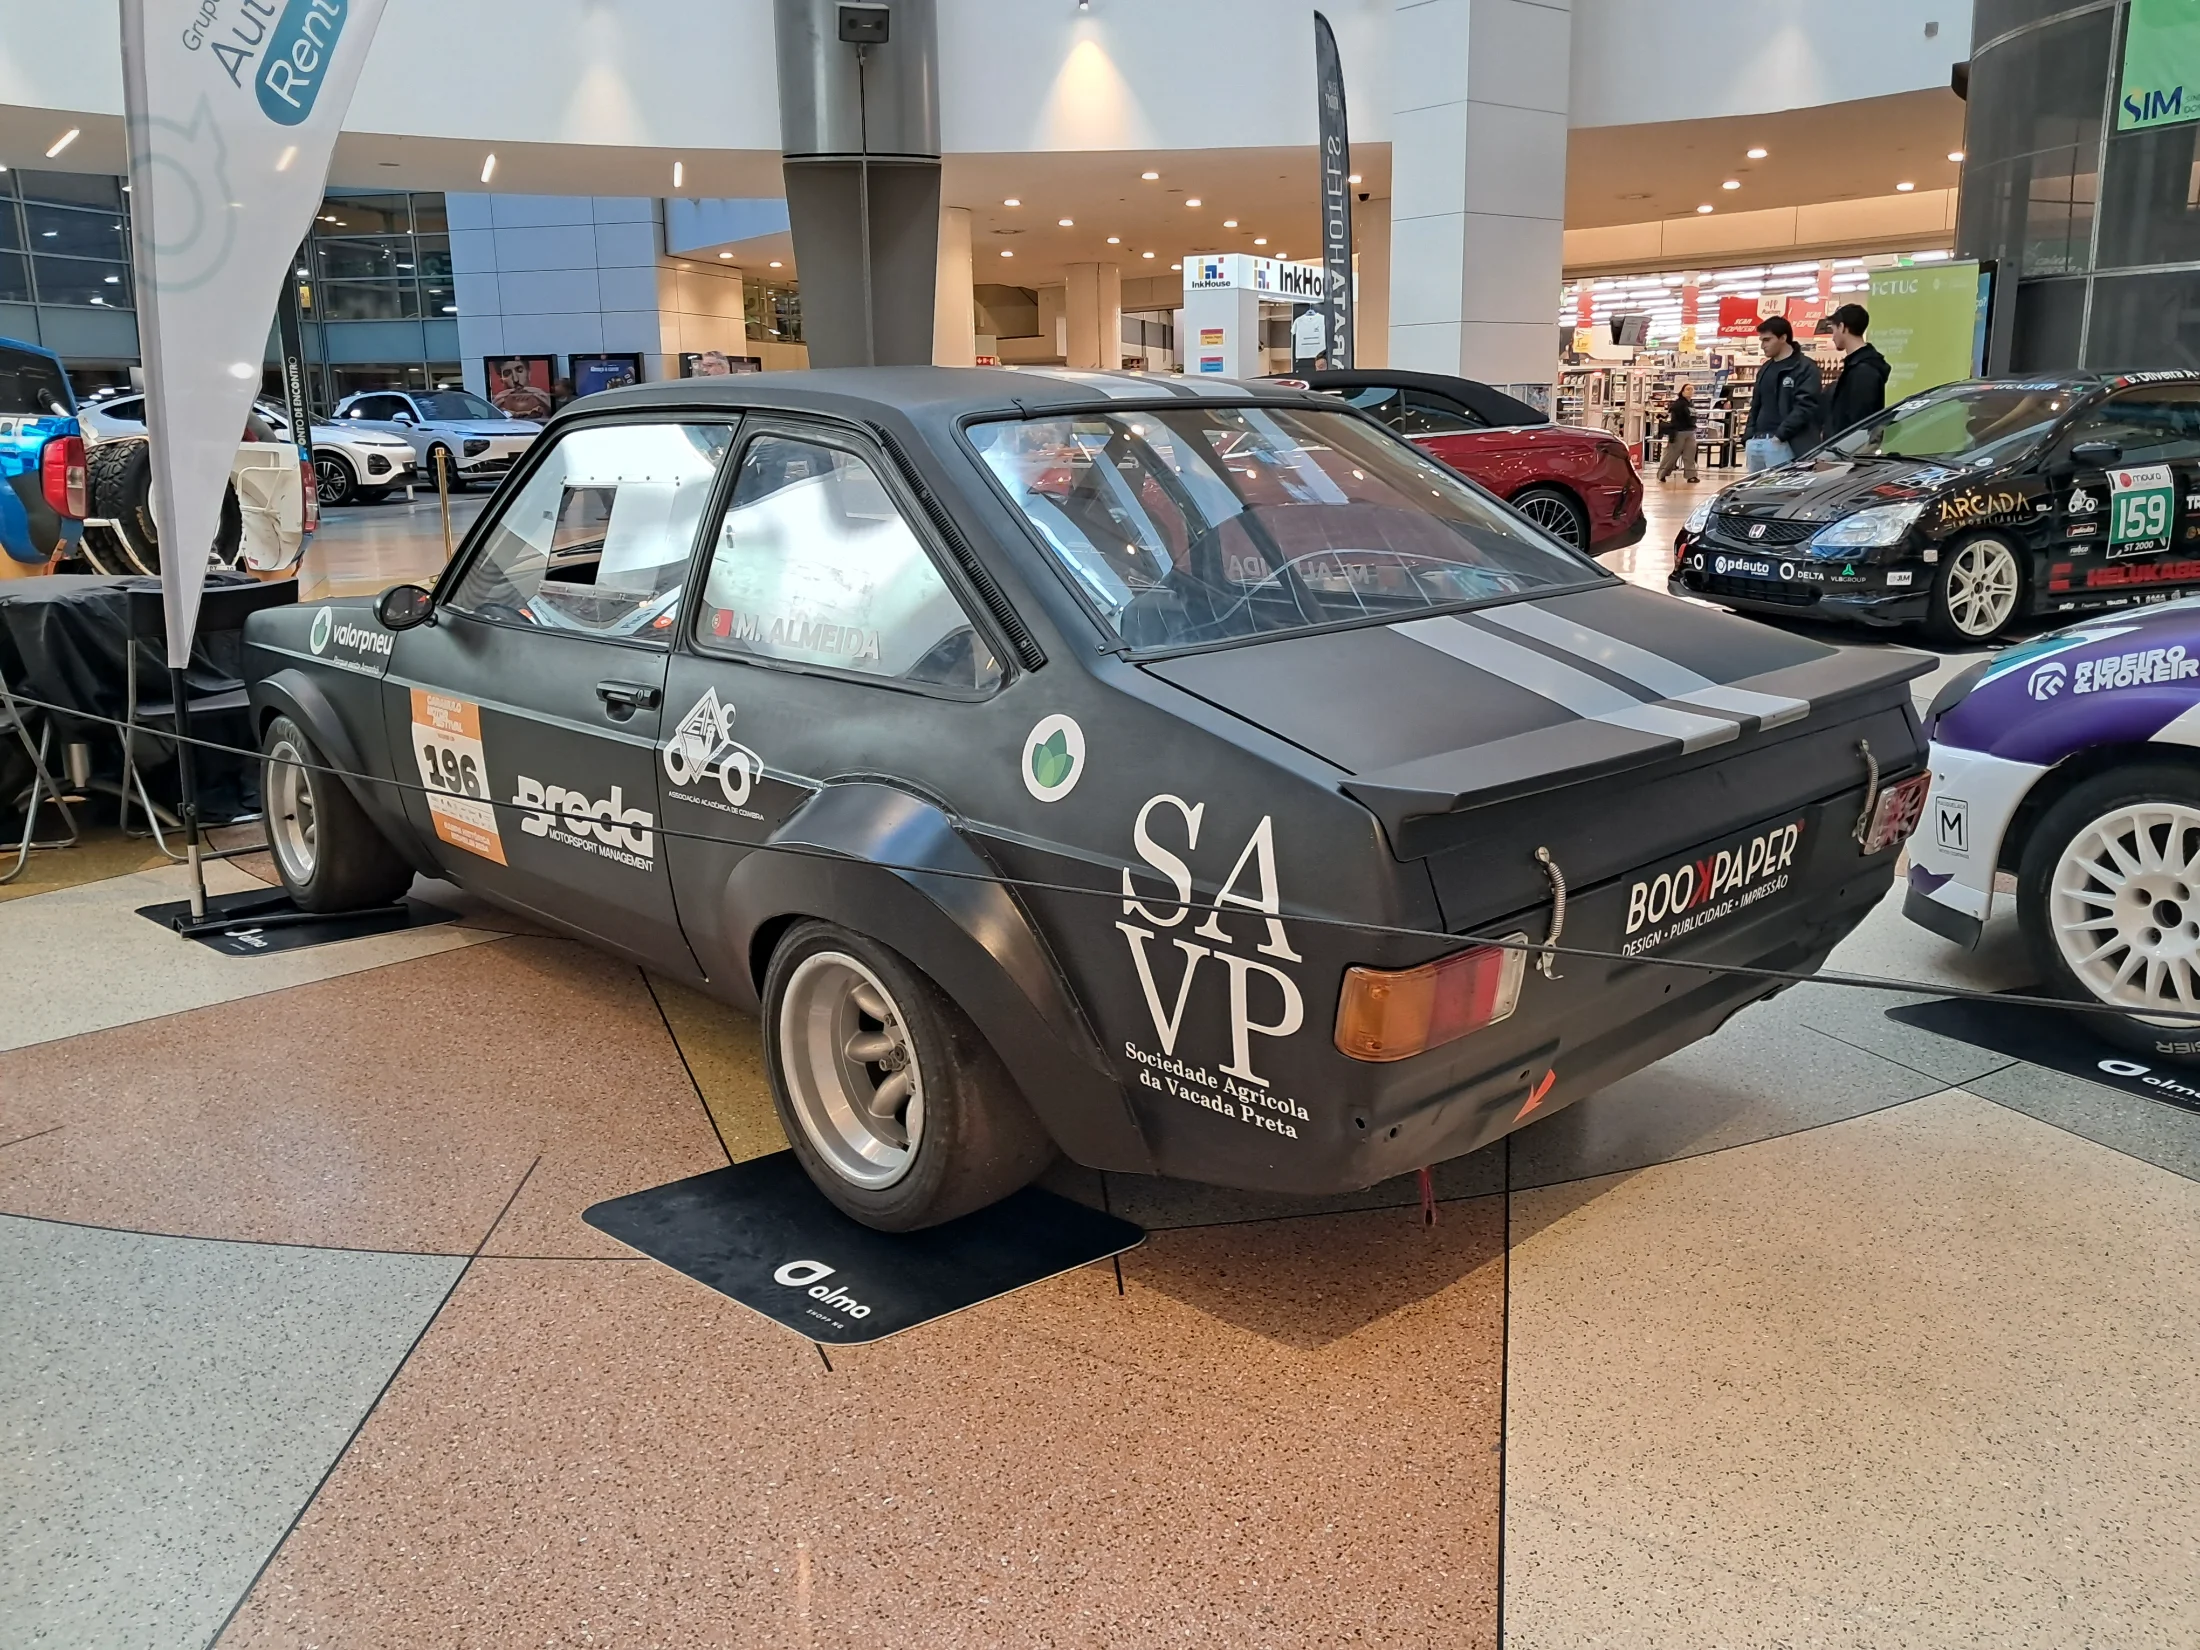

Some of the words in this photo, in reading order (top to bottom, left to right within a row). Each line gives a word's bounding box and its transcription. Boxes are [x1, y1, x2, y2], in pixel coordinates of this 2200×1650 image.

[182, 0, 221, 51] Grup
[2124, 86, 2182, 123] SIM
[1192, 280, 1231, 288] InkHouse
[288, 356, 303, 406] ENCONTRO
[294, 407, 304, 421] DE
[296, 420, 306, 446] ONTO
[2133, 473, 2161, 483] moura
[1940, 492, 2030, 522] ARCADA
[2118, 495, 2166, 539] 159
[2124, 544, 2133, 552] ST
[2135, 541, 2154, 551] 2000
[1727, 558, 1770, 573] pdauto
[1797, 571, 1824, 581] DELTA
[333, 622, 393, 655] valorpneu
[736, 613, 762, 643] M.
[768, 617, 880, 660] ALMEIDA
[2075, 645, 2186, 679] RIBEIRO
[423, 744, 481, 797] 196
[512, 775, 653, 858] Breda
[1941, 810, 1962, 846] M
[549, 828, 598, 854] MOTORSPORT
[599, 844, 654, 872] MANAGEMENT
[1122, 794, 1302, 963] SA
[1625, 824, 1798, 935] BOOKPAPER
[1622, 930, 1661, 957] DESIGN
[1670, 899, 1734, 939] PUBLICIDADE
[1740, 874, 1788, 908] IMPRESSÃO
[1115, 921, 1304, 1087] VP
[1125, 1041, 1218, 1089] Sociedade
[1223, 1077, 1310, 1121] Agrícola
[1139, 1069, 1162, 1091] da
[1165, 1077, 1235, 1118] Vacada
[1240, 1103, 1298, 1140] Preta
[806, 1309, 844, 1329] SHOPPNG
[808, 1286, 871, 1319] alma
